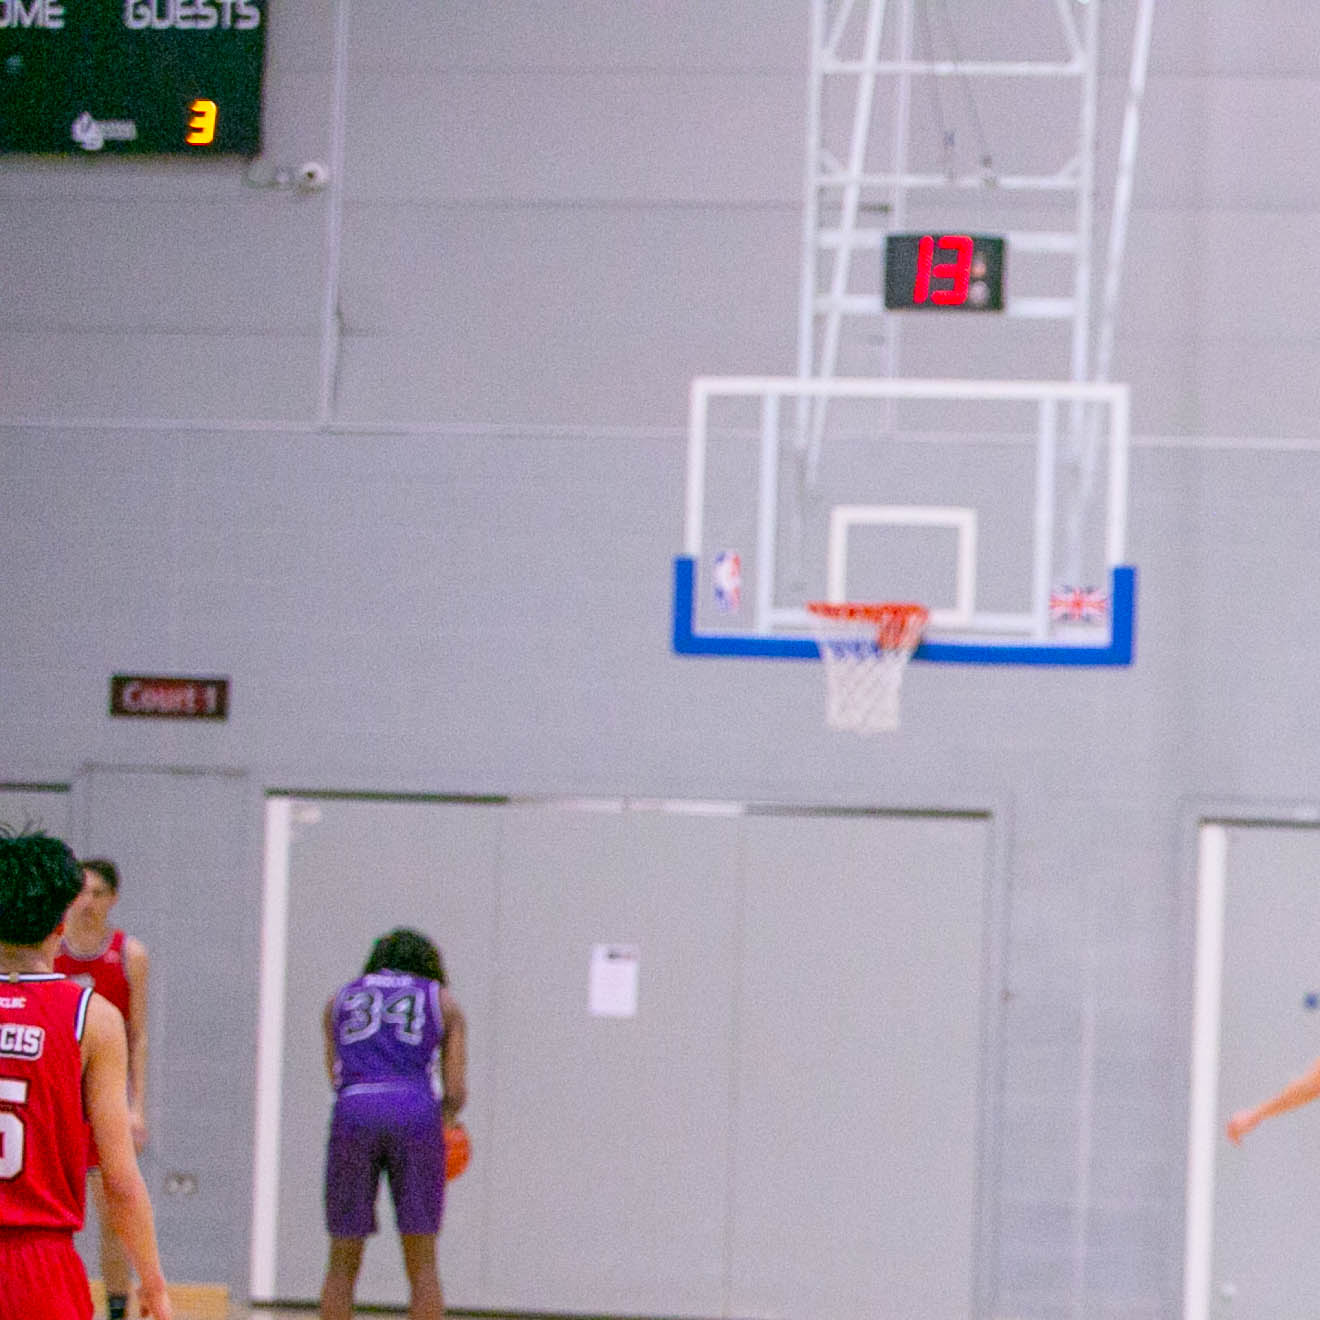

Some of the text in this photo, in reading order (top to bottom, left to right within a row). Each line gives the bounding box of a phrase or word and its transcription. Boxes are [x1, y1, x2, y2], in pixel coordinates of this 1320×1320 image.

[124, 0, 261, 29] GUESTS
[186, 98, 217, 146] 3
[913, 235, 974, 305] 13
[123, 682, 195, 713] Court
[339, 988, 426, 1045] 34
